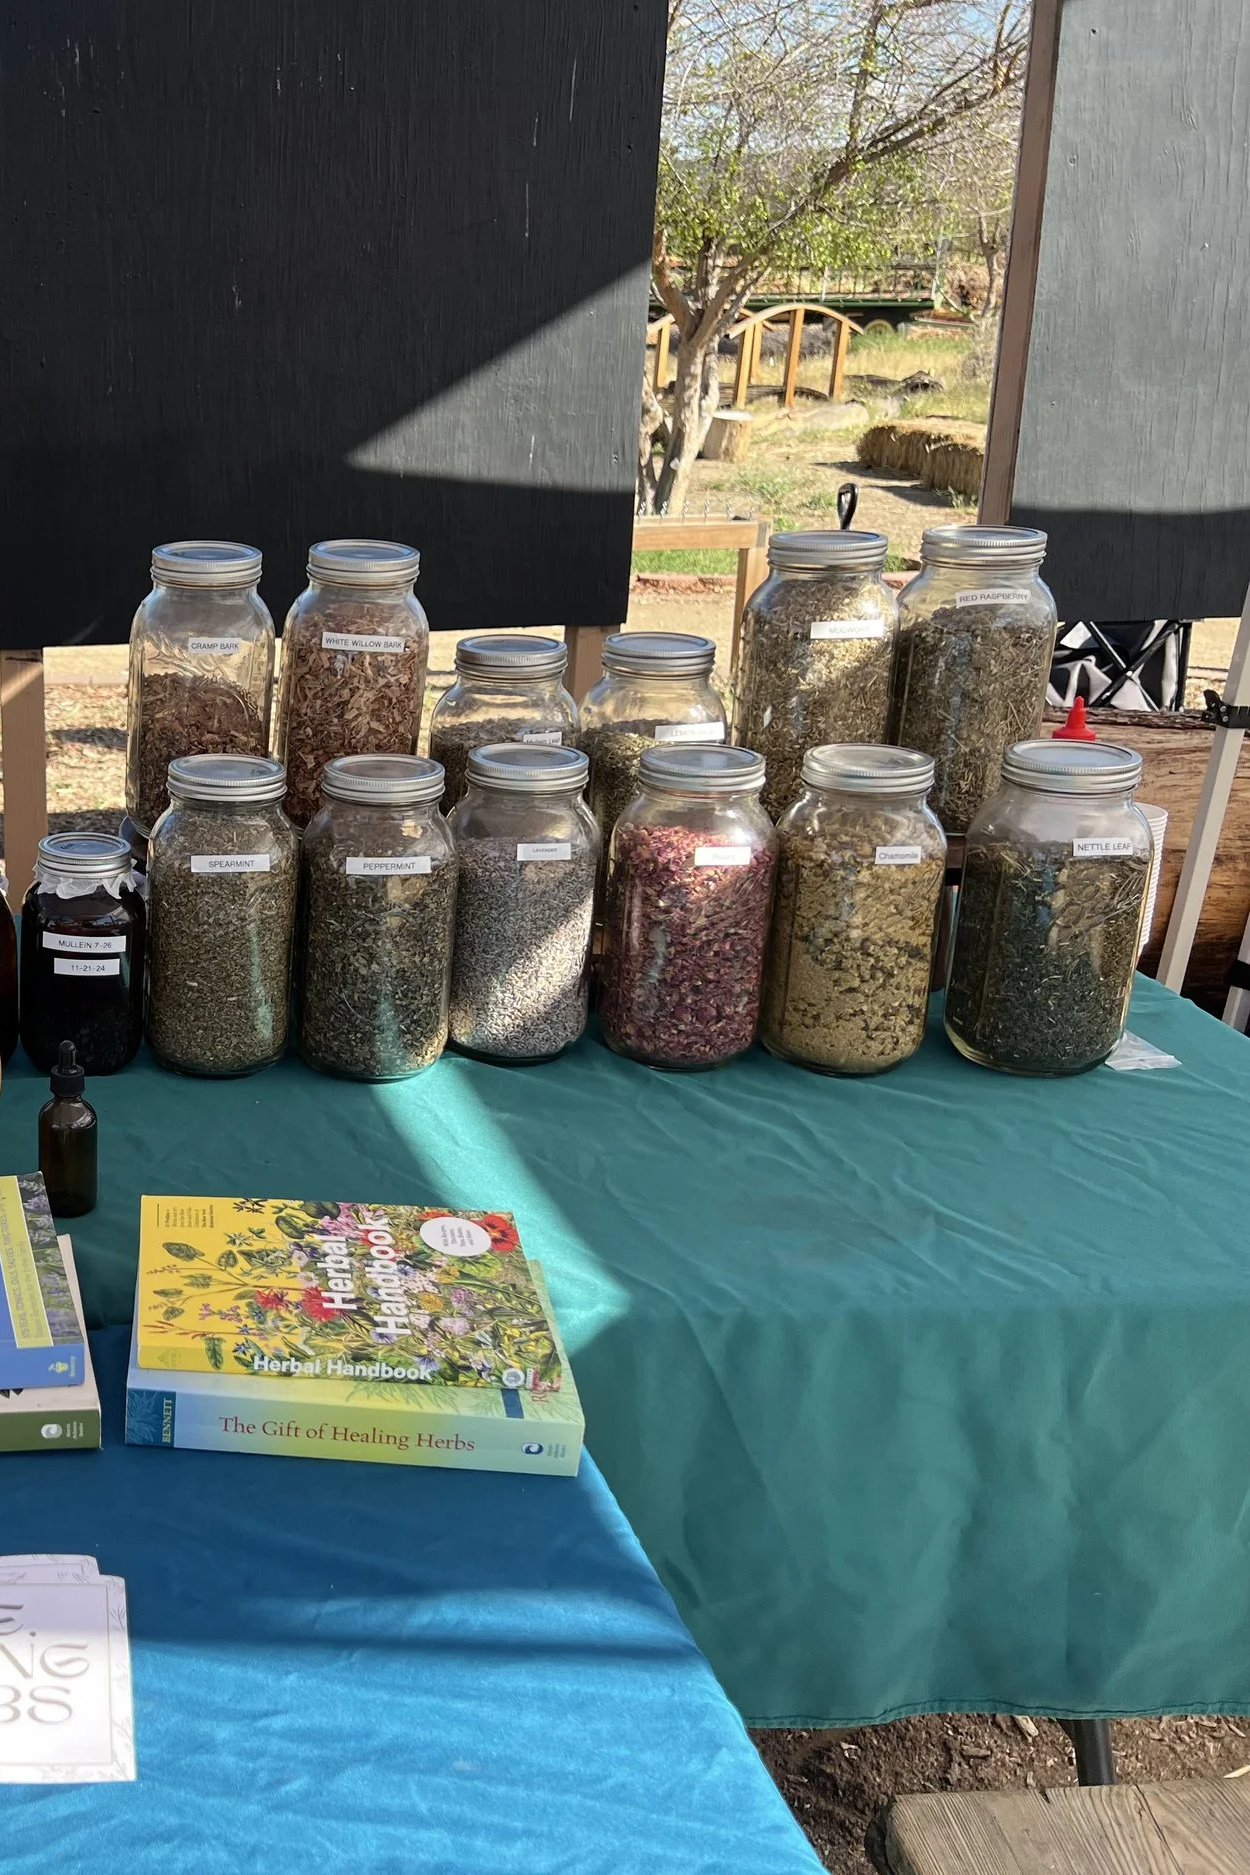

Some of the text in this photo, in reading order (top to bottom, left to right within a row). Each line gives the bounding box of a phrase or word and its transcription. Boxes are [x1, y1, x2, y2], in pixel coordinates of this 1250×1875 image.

[959, 592, 1028, 603] RED RASPBERRY
[191, 642, 239, 651] CRAMP BARK
[325, 637, 403, 650] WHITE WILLOW BARK
[1078, 841, 1132, 852] NETTLE LEAF
[878, 850, 919, 861] Chamomile
[208, 860, 256, 869] SPEARMINT
[363, 862, 416, 871] PEPPERMINT
[59, 940, 112, 949] MULLEIN 7-26
[71, 964, 106, 973] 11-21-24
[322, 1235, 357, 1310] Herbal
[358, 1218, 411, 1335] Handbook
[253, 1355, 433, 1381] Herbal Handbook
[162, 1399, 173, 1445] BENNETT
[219, 1416, 475, 1451] The Gift of Healing Herbs
